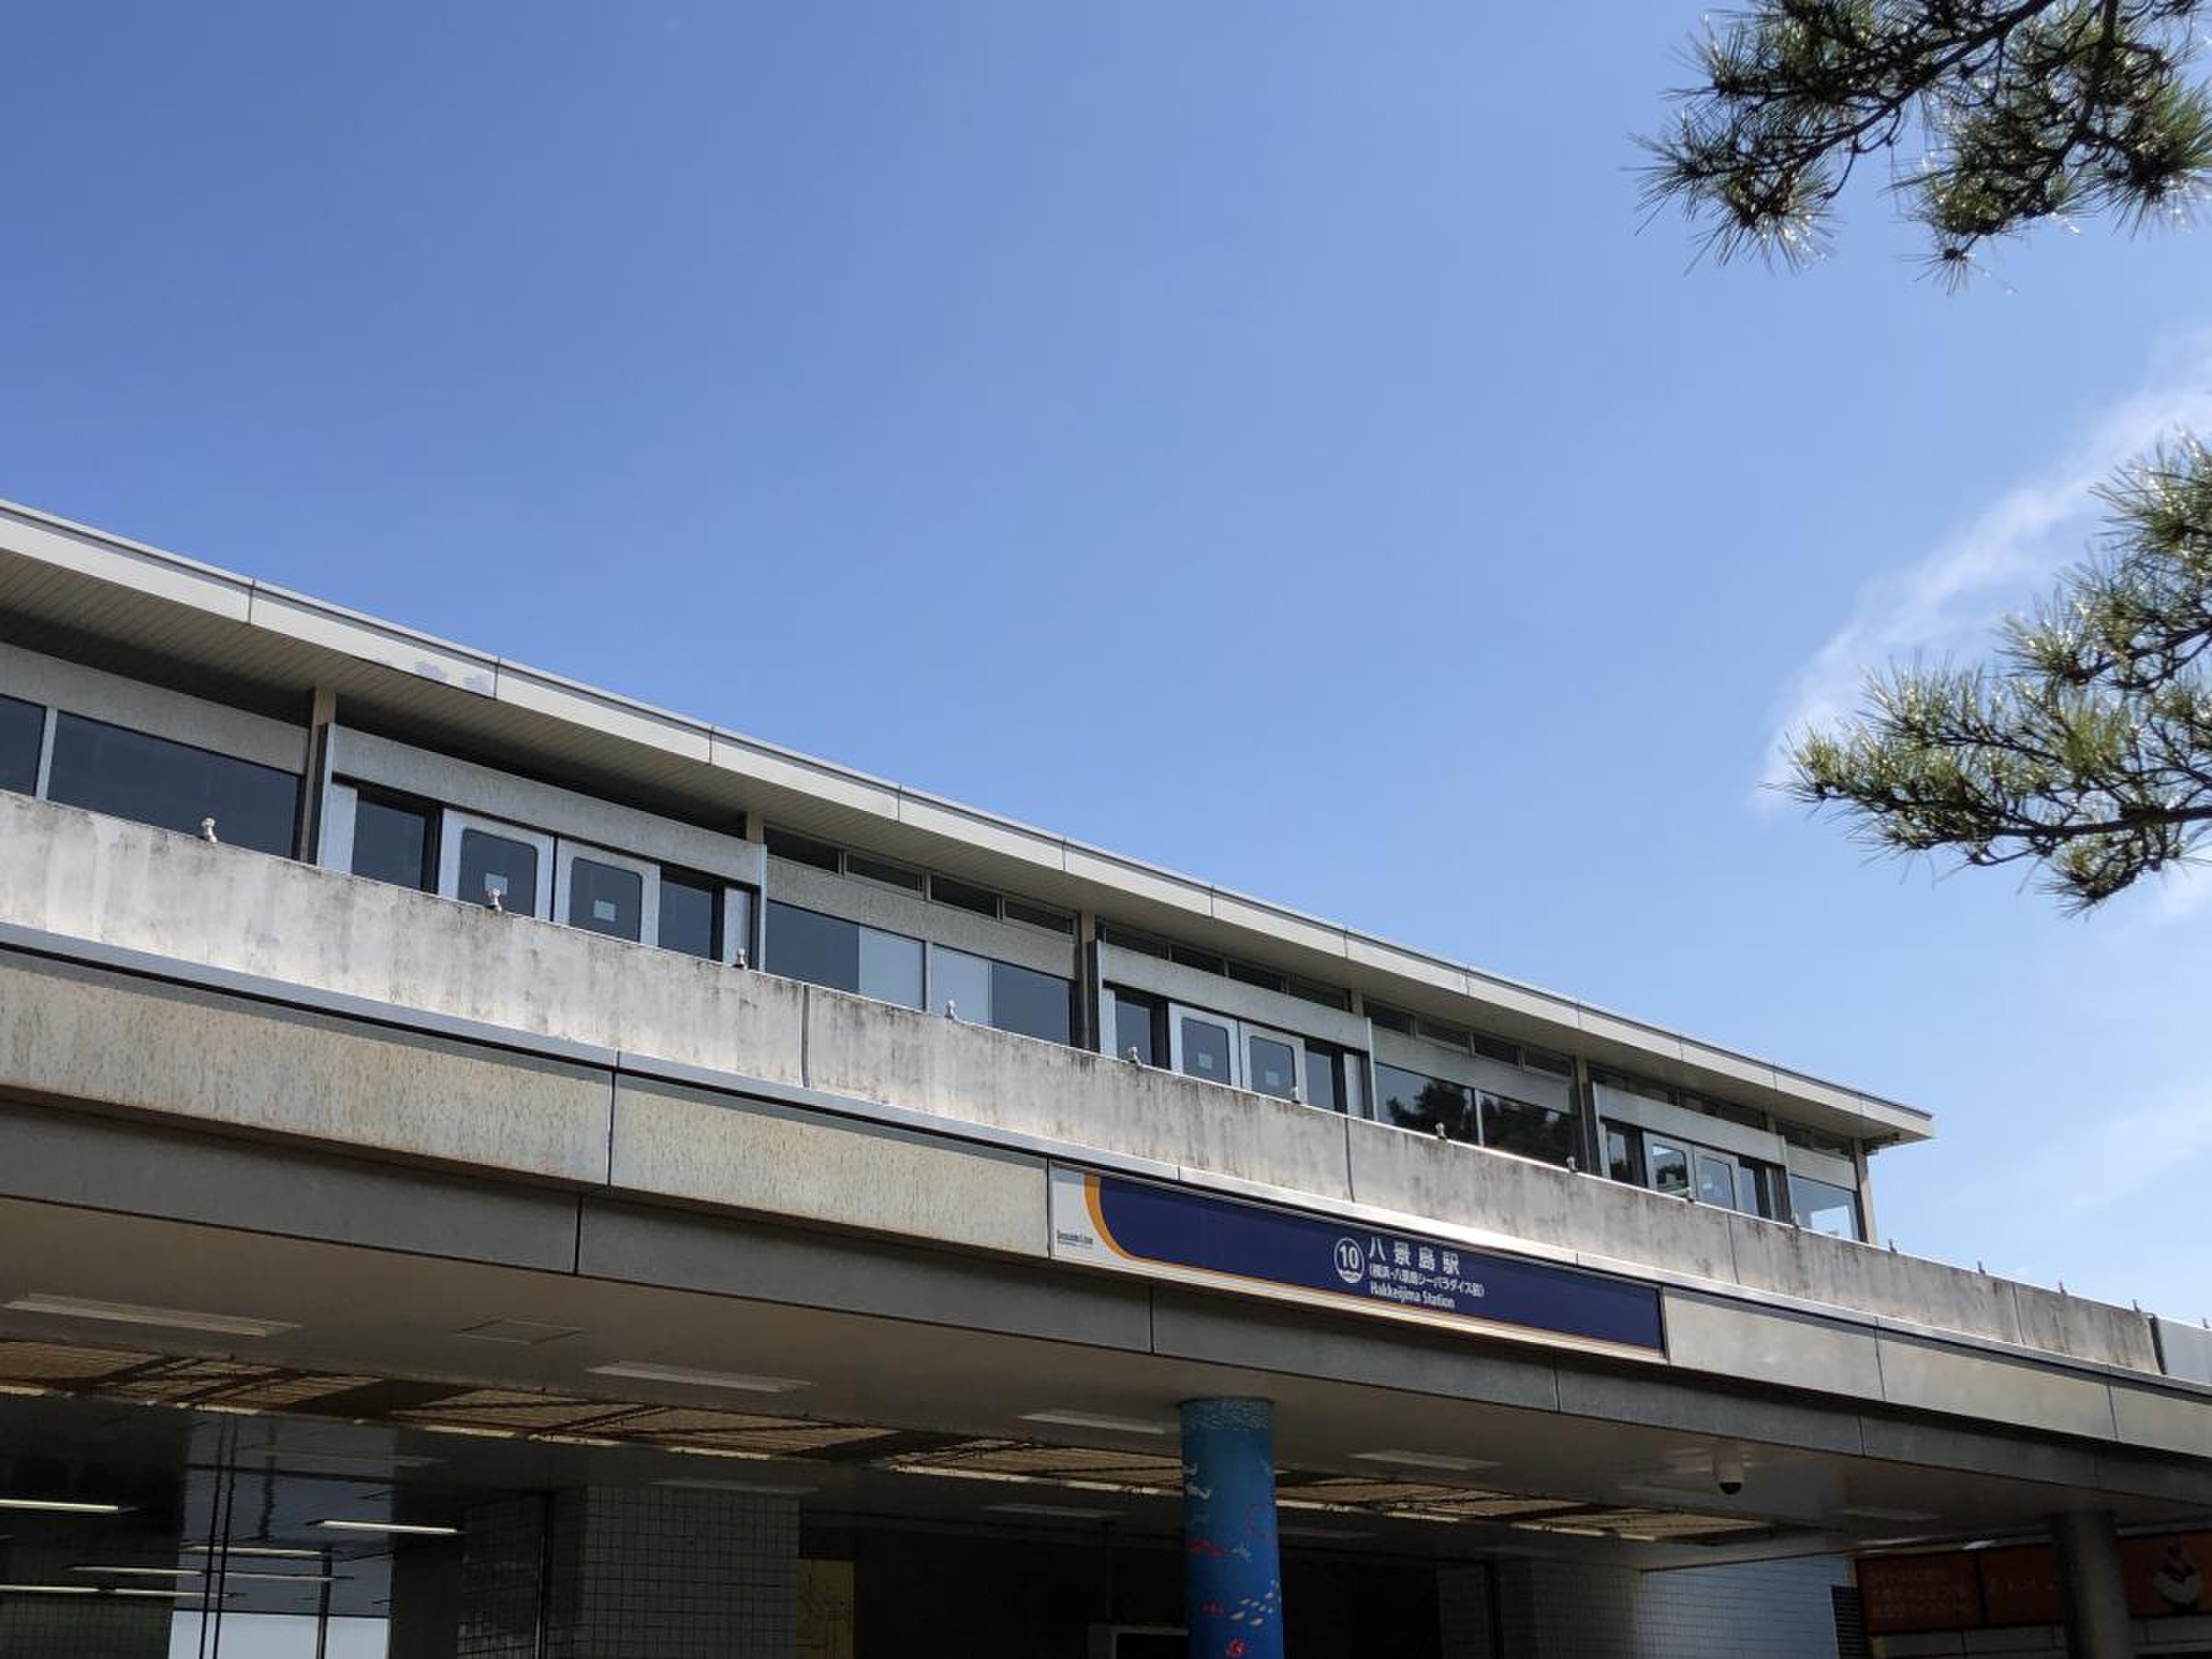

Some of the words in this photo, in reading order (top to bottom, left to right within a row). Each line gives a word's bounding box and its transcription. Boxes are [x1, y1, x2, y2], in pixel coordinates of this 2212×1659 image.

[1339, 1244, 1360, 1269] 10
[1369, 1237, 1461, 1276] 八景島駅
[1371, 1281, 1420, 1303] Hakkeijima
[1422, 1290, 1456, 1309] Station
